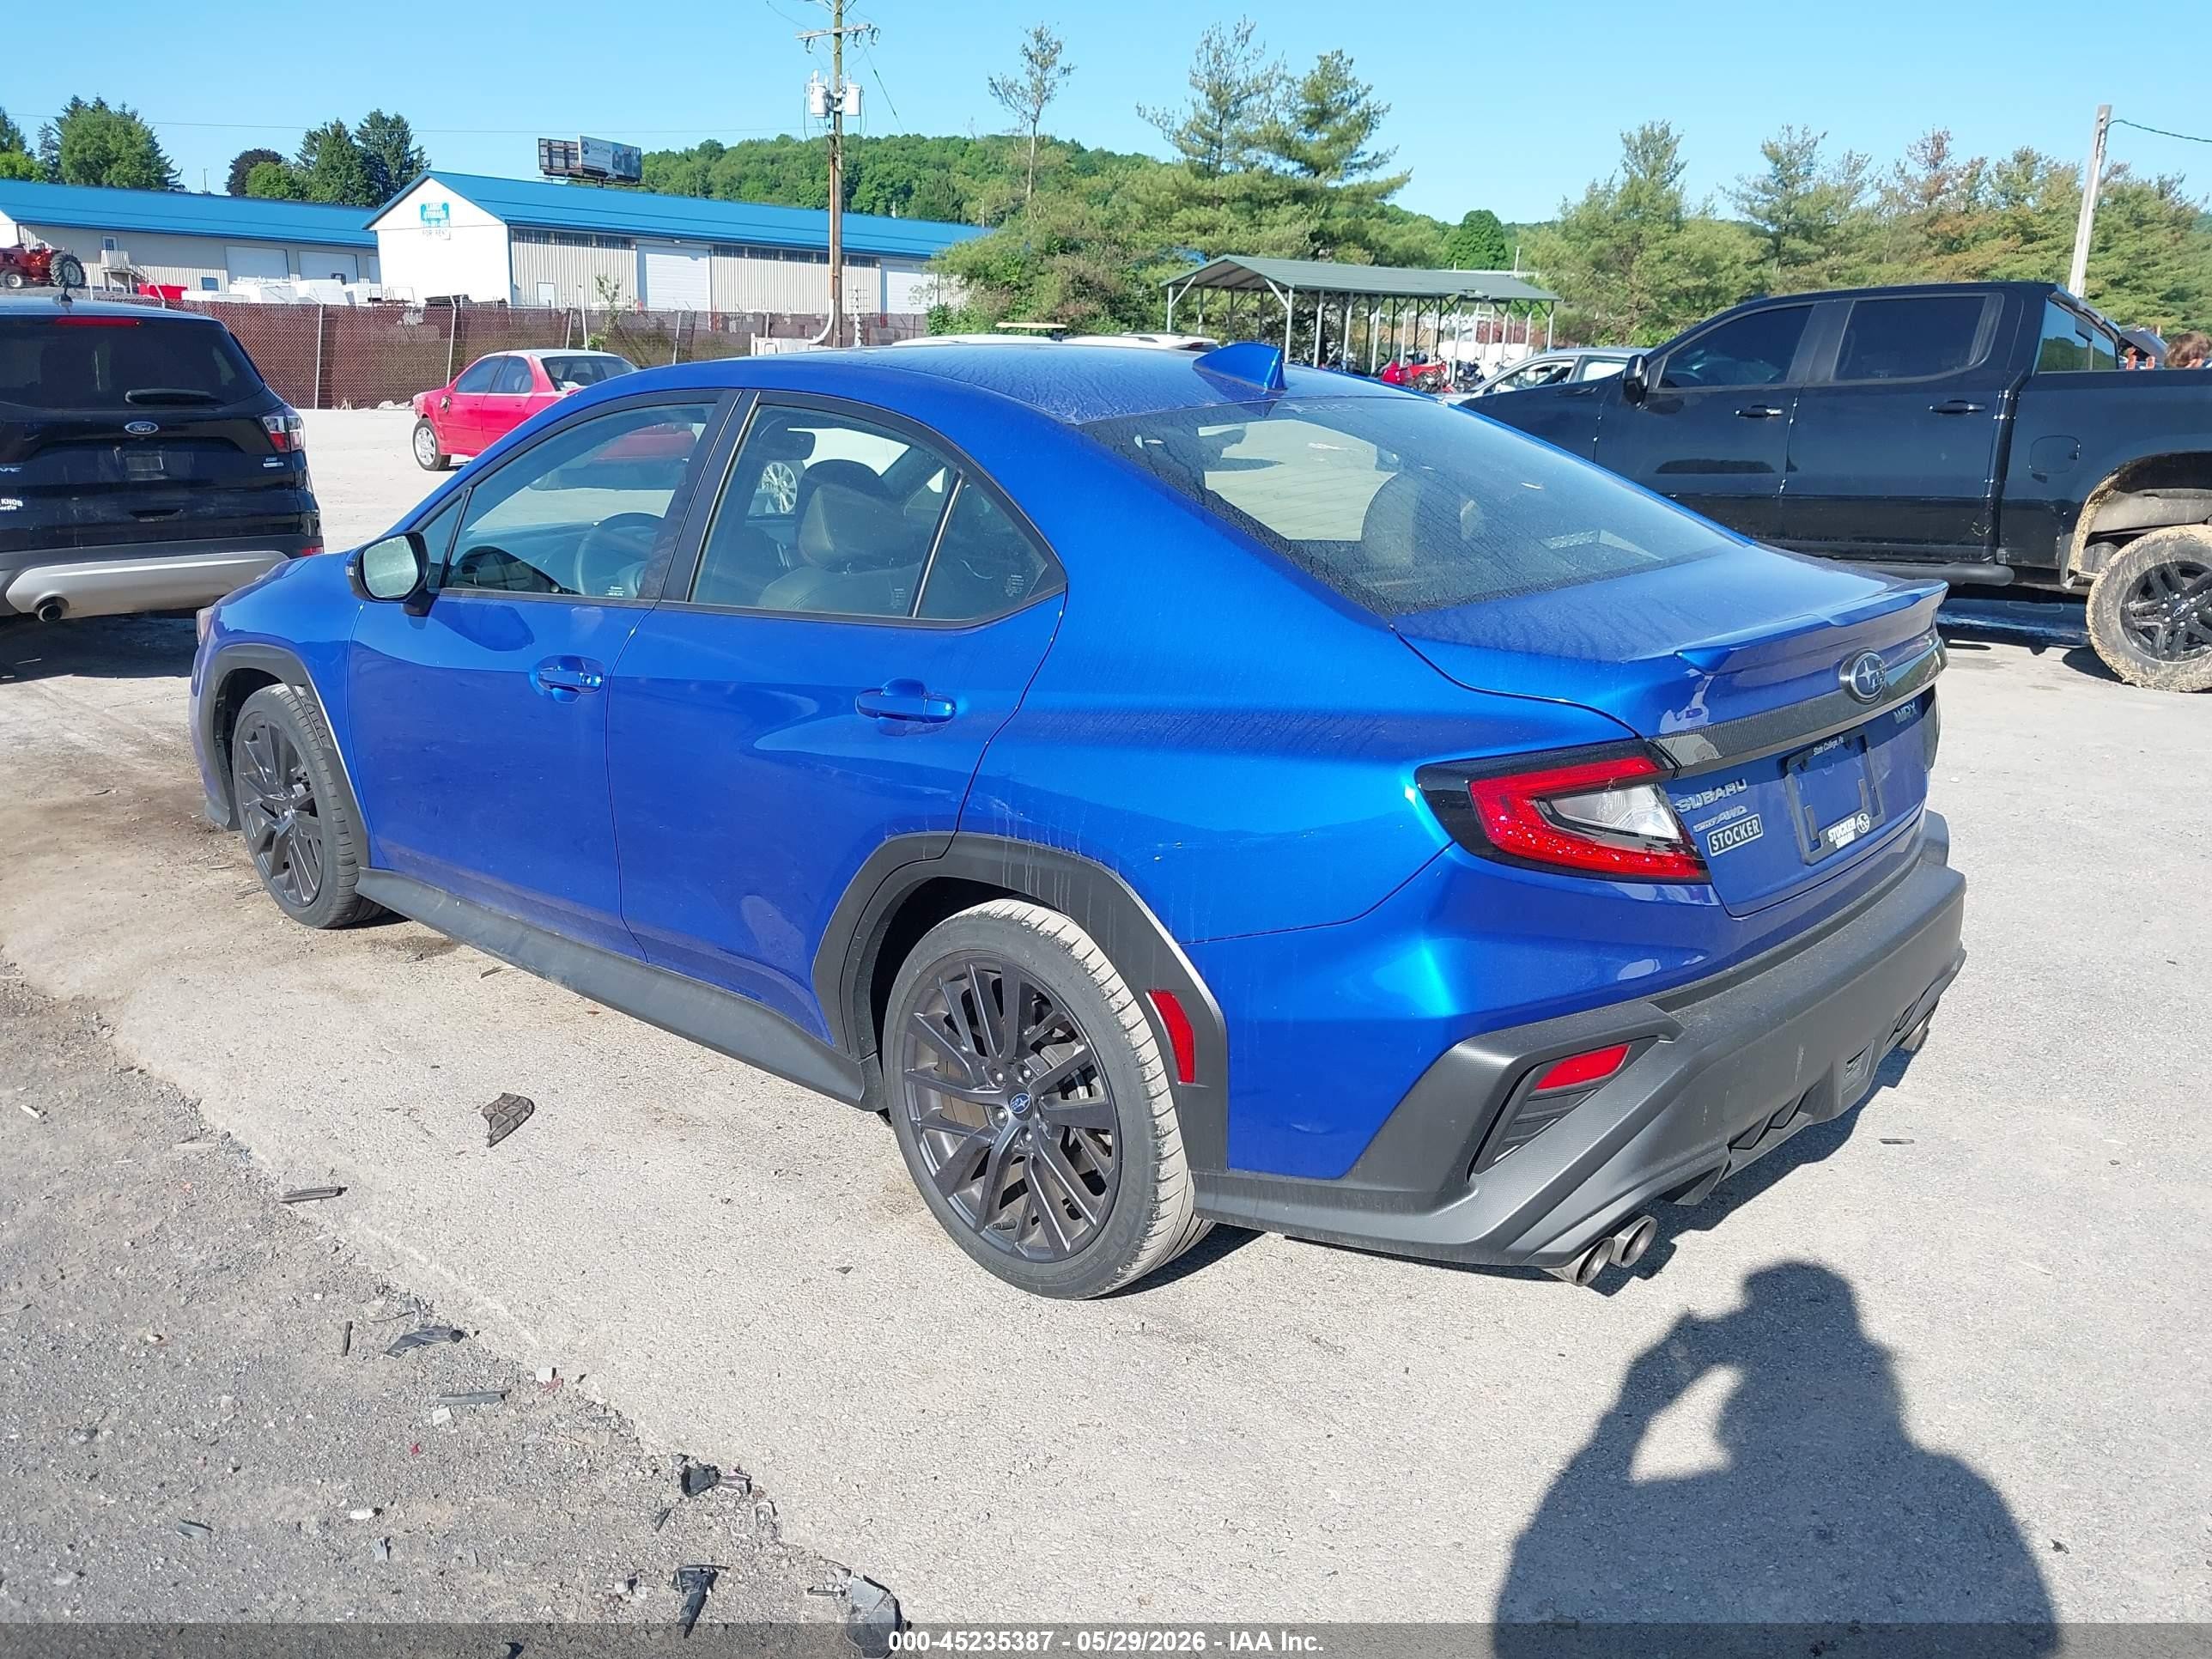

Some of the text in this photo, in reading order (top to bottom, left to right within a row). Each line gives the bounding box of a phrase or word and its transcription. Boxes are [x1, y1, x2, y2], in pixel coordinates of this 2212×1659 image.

[1893, 702, 1917, 724] WRX
[1674, 778, 1747, 814] SUBARU
[1711, 819, 1761, 852] STOCKER
[1827, 817, 1856, 843] STOCKER
